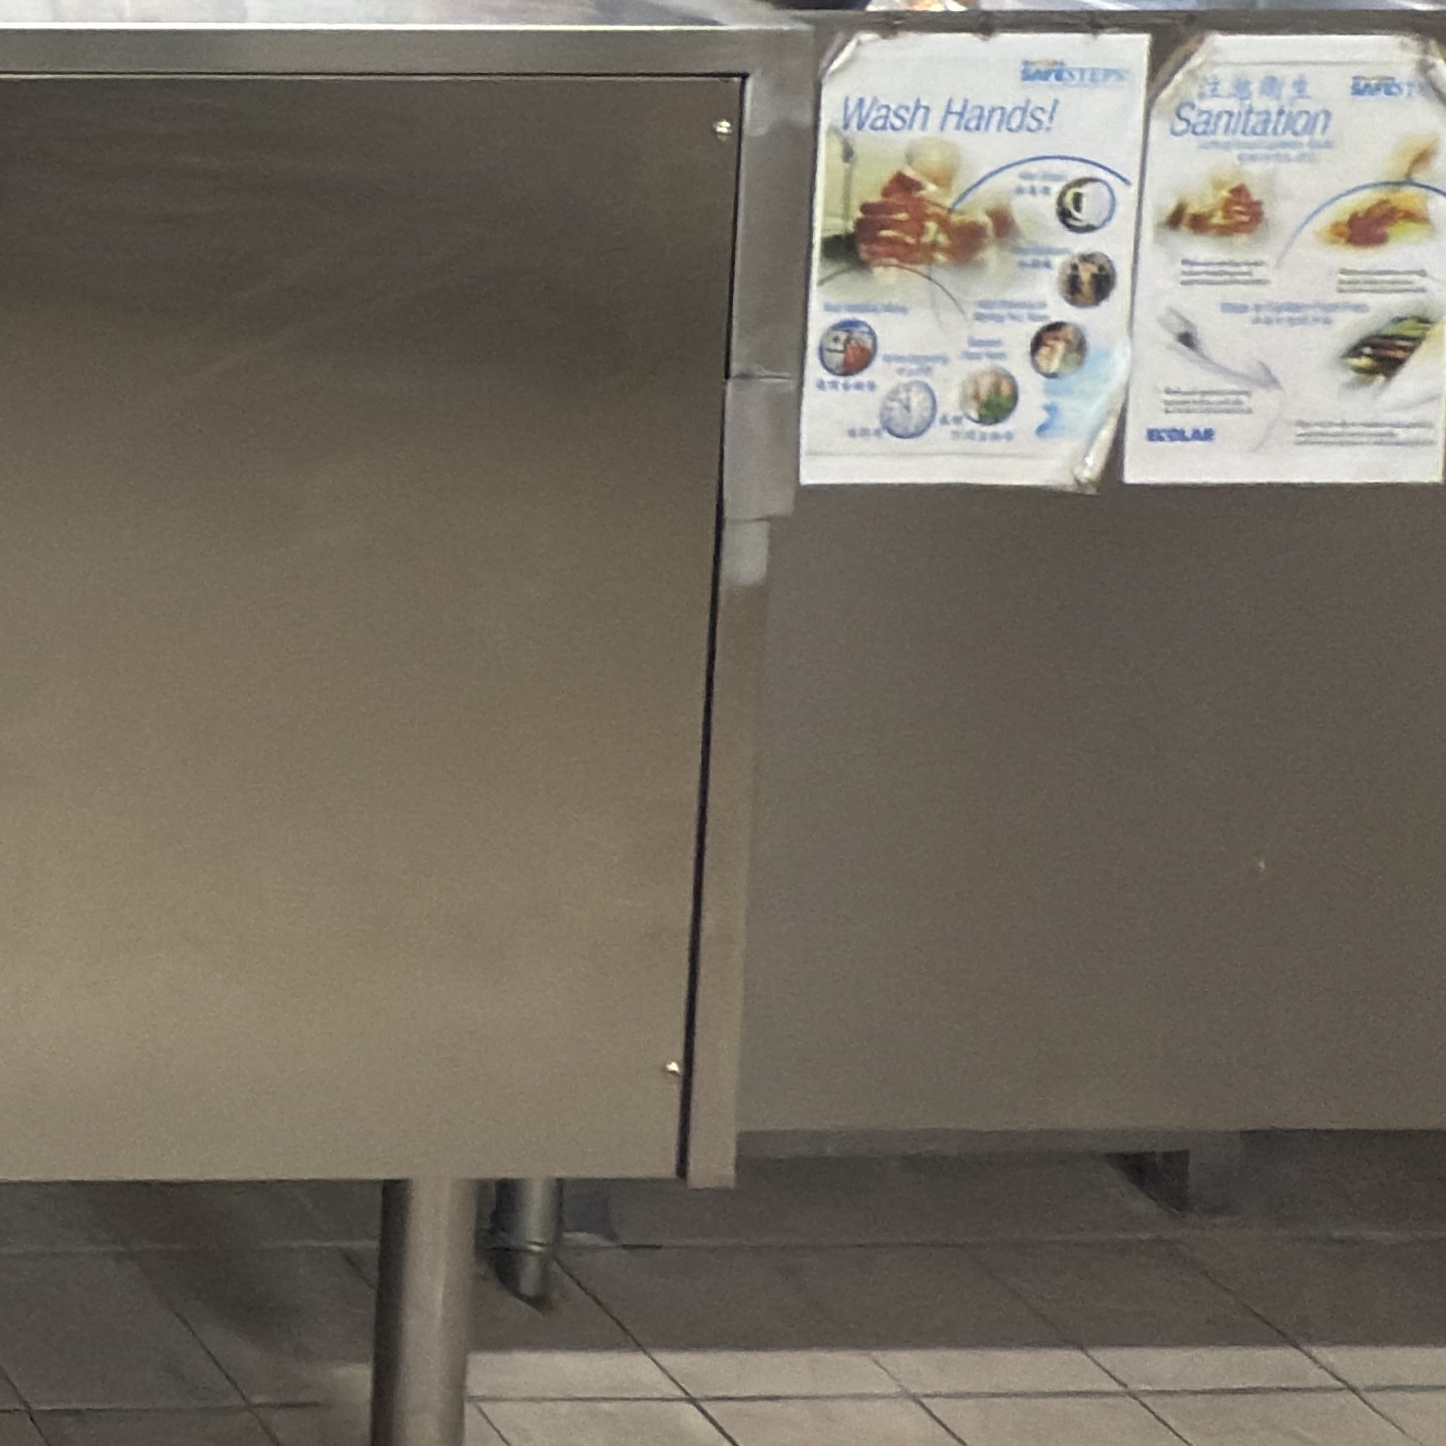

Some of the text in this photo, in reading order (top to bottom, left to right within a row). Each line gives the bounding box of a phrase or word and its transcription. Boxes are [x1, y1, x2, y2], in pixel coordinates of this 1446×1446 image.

[842, 95, 1060, 133] Wash Hands!
[1169, 101, 1333, 137] Sanitation
